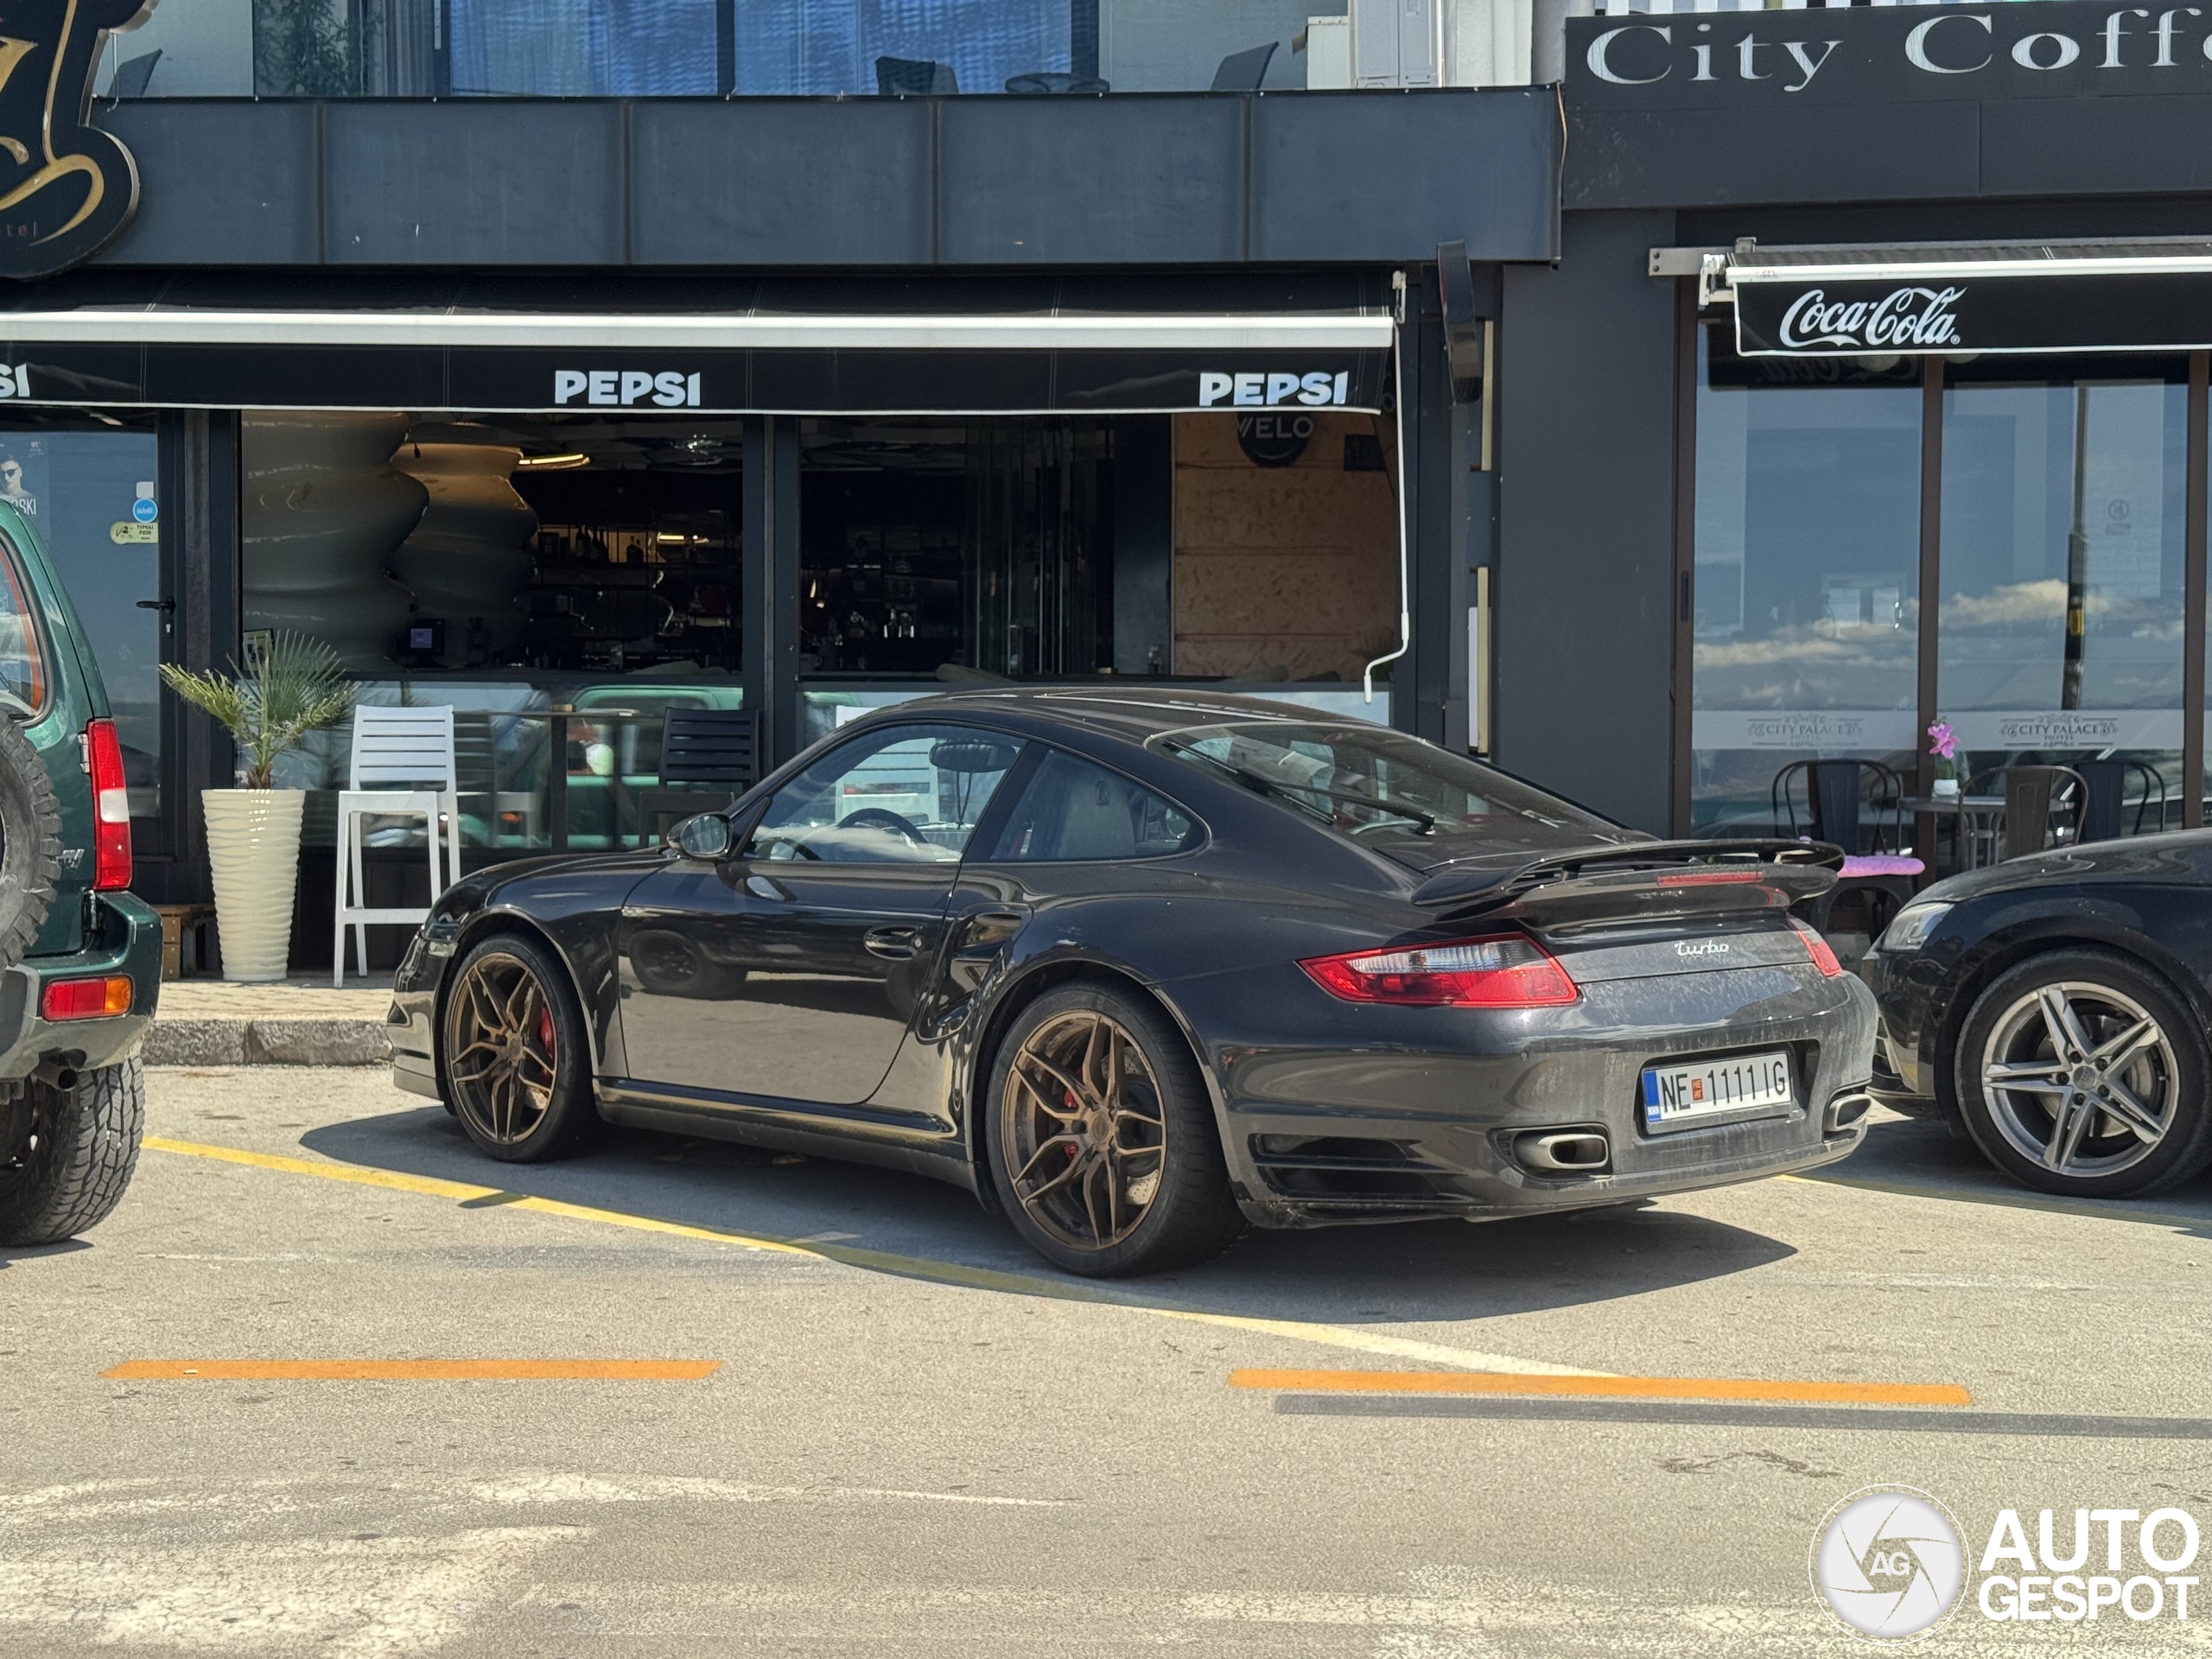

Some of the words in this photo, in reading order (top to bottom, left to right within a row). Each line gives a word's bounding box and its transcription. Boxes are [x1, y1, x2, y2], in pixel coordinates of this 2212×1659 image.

[1586, 22, 1844, 92] City
[1904, 7, 2212, 74] Coff
[555, 370, 701, 407] PEPSI
[1198, 371, 1349, 406] PEPSI
[1766, 724, 1796, 735] CITY
[1799, 724, 1842, 735] PALACE
[2018, 724, 2050, 735] CITY
[2053, 724, 2099, 735] PALACE
[1674, 938, 1730, 957] turbo
